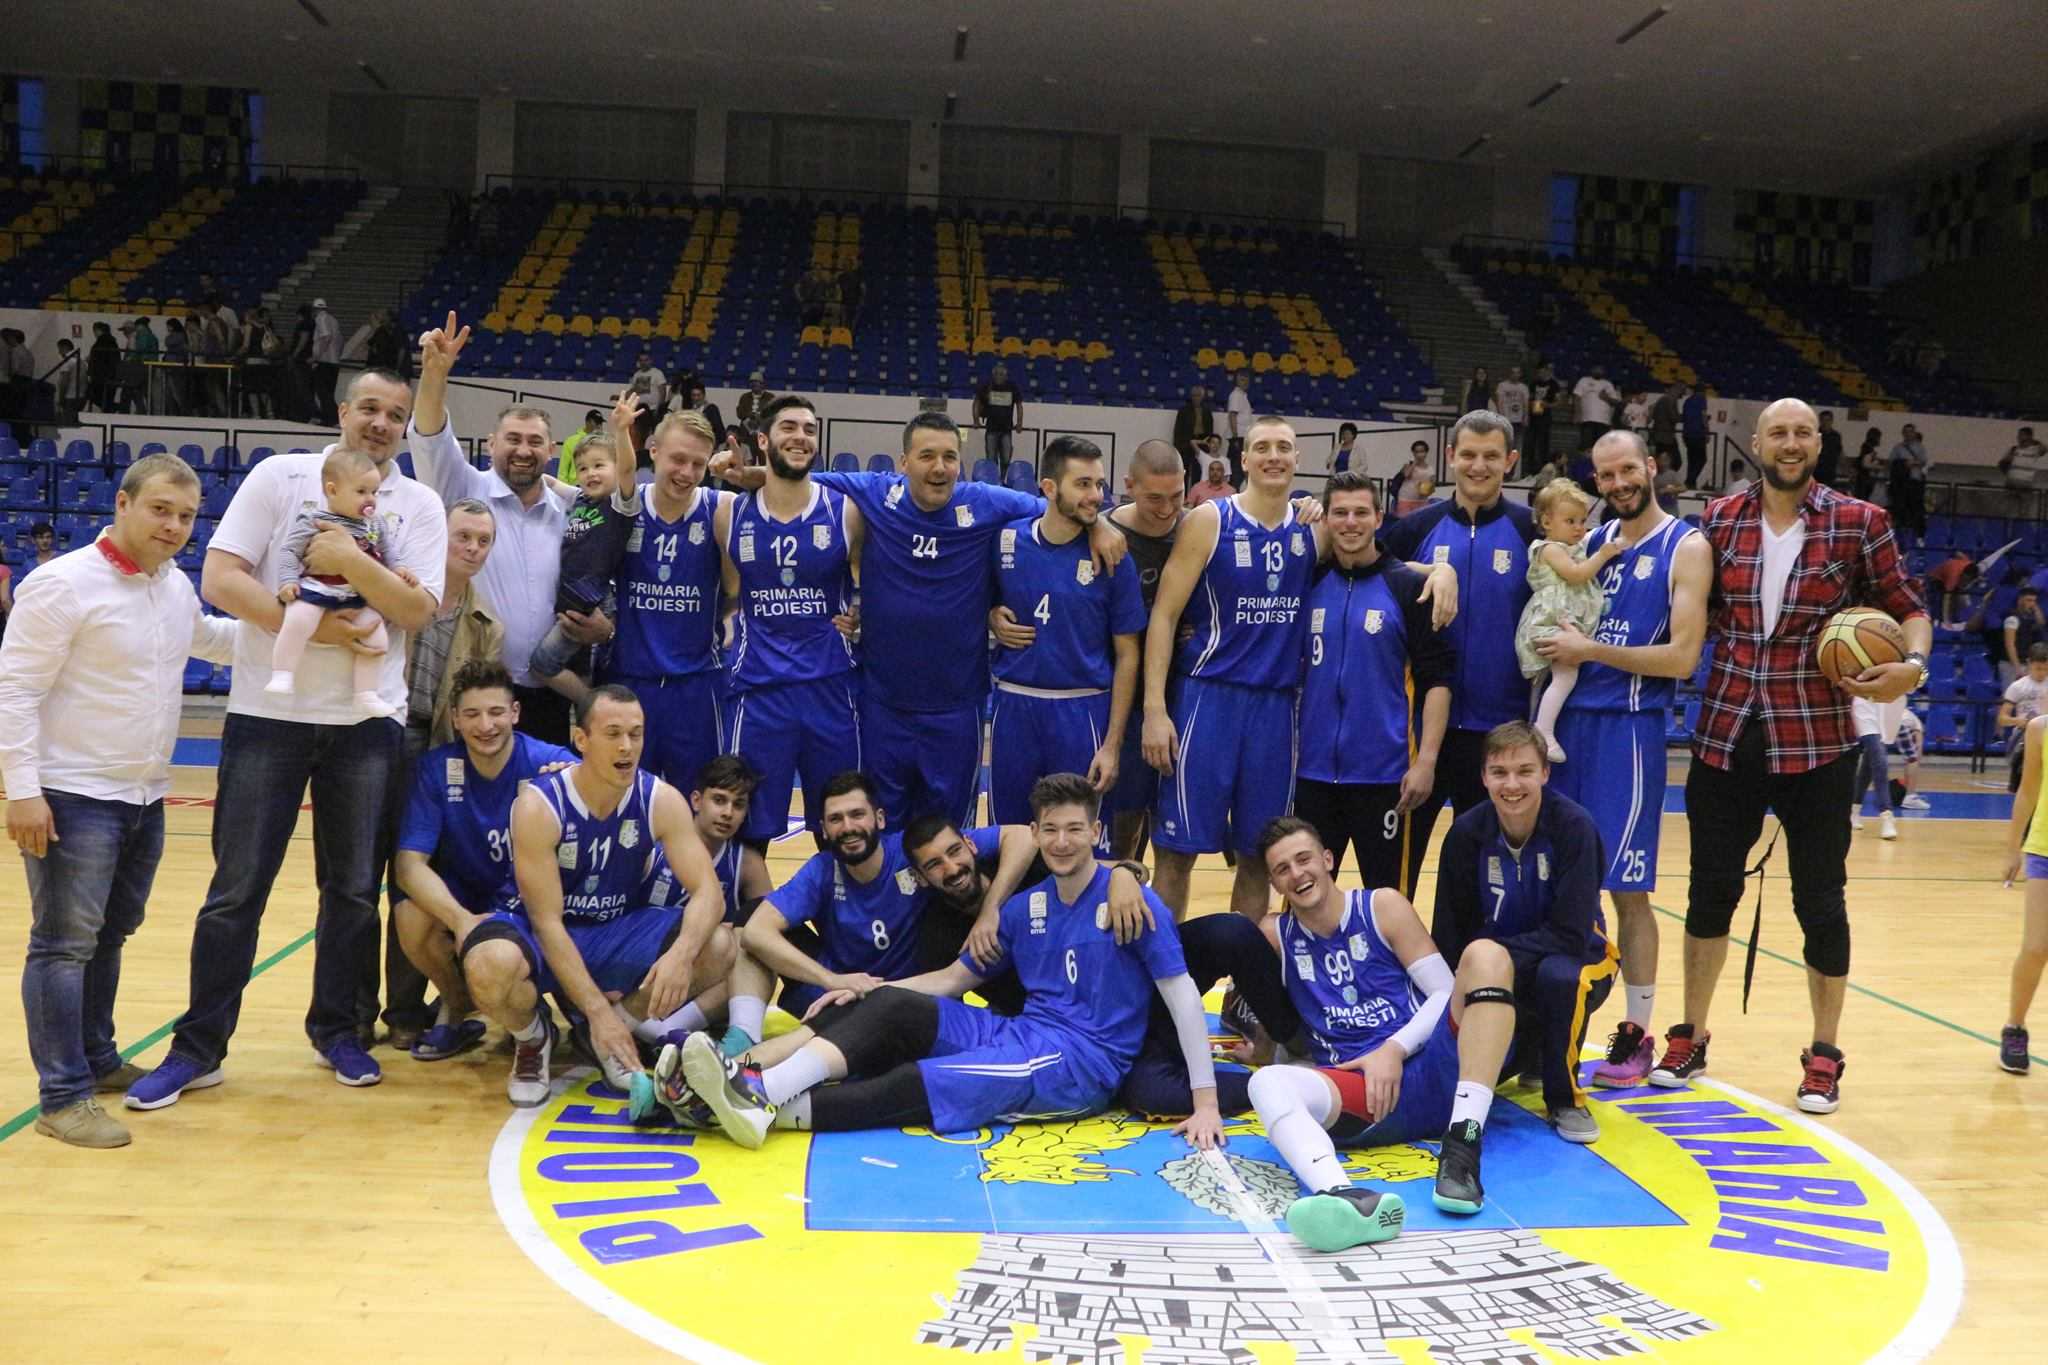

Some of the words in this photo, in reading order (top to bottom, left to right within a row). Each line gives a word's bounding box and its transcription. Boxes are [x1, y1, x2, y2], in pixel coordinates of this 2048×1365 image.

[653, 533, 678, 563] 14
[770, 535, 798, 567] 12
[912, 534, 938, 560] 24
[1261, 541, 1283, 572] 13
[629, 581, 701, 598] PRIMARIA
[750, 587, 825, 601] PRIMARIA
[1603, 563, 1625, 595] 25
[629, 596, 701, 613] PLOIESTI
[754, 600, 828, 617] PLOIESTI
[1034, 593, 1050, 625] 4
[1237, 597, 1300, 609] PRIMARIA
[1311, 634, 1324, 667] 9
[1099, 823, 1111, 854] 4
[1383, 810, 1399, 840] 9
[487, 828, 513, 863] 31
[588, 837, 612, 872] 11
[1621, 849, 1646, 883] 25
[1491, 888, 1505, 922] 7
[871, 919, 891, 950] 8
[1065, 949, 1078, 985] 6
[1324, 949, 1355, 987] 99
